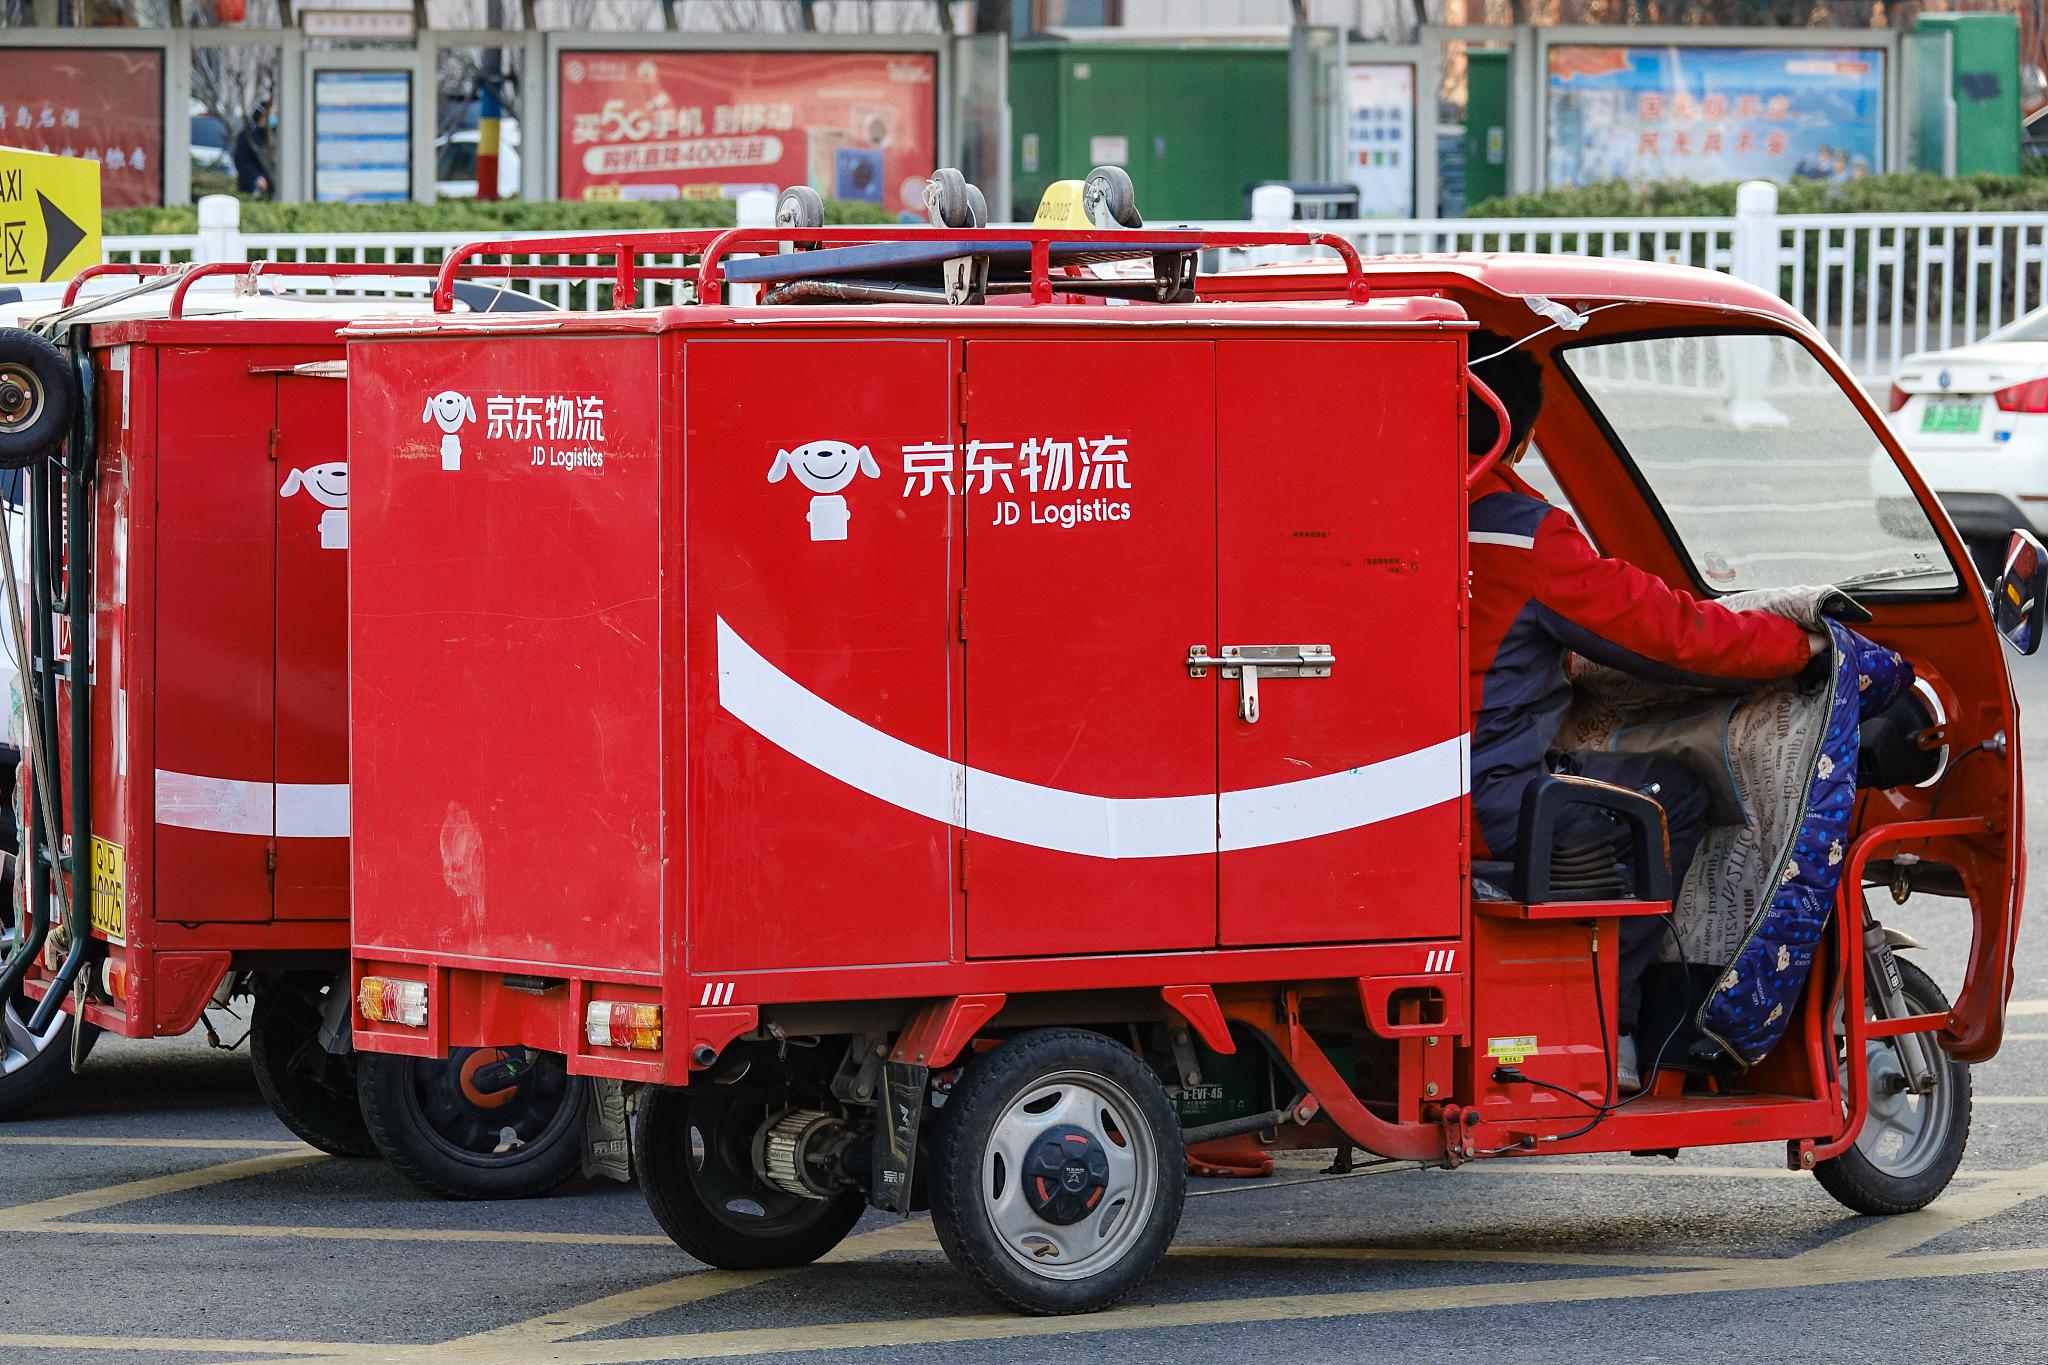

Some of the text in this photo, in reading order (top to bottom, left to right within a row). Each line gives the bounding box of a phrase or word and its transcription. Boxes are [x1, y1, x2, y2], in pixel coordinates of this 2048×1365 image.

[0, 221, 27, 275] 区
[486, 395, 604, 440] 京东物流
[531, 447, 604, 471] JD Logistics
[901, 435, 1131, 498] 京东物流
[992, 497, 1131, 529] JD Logistics
